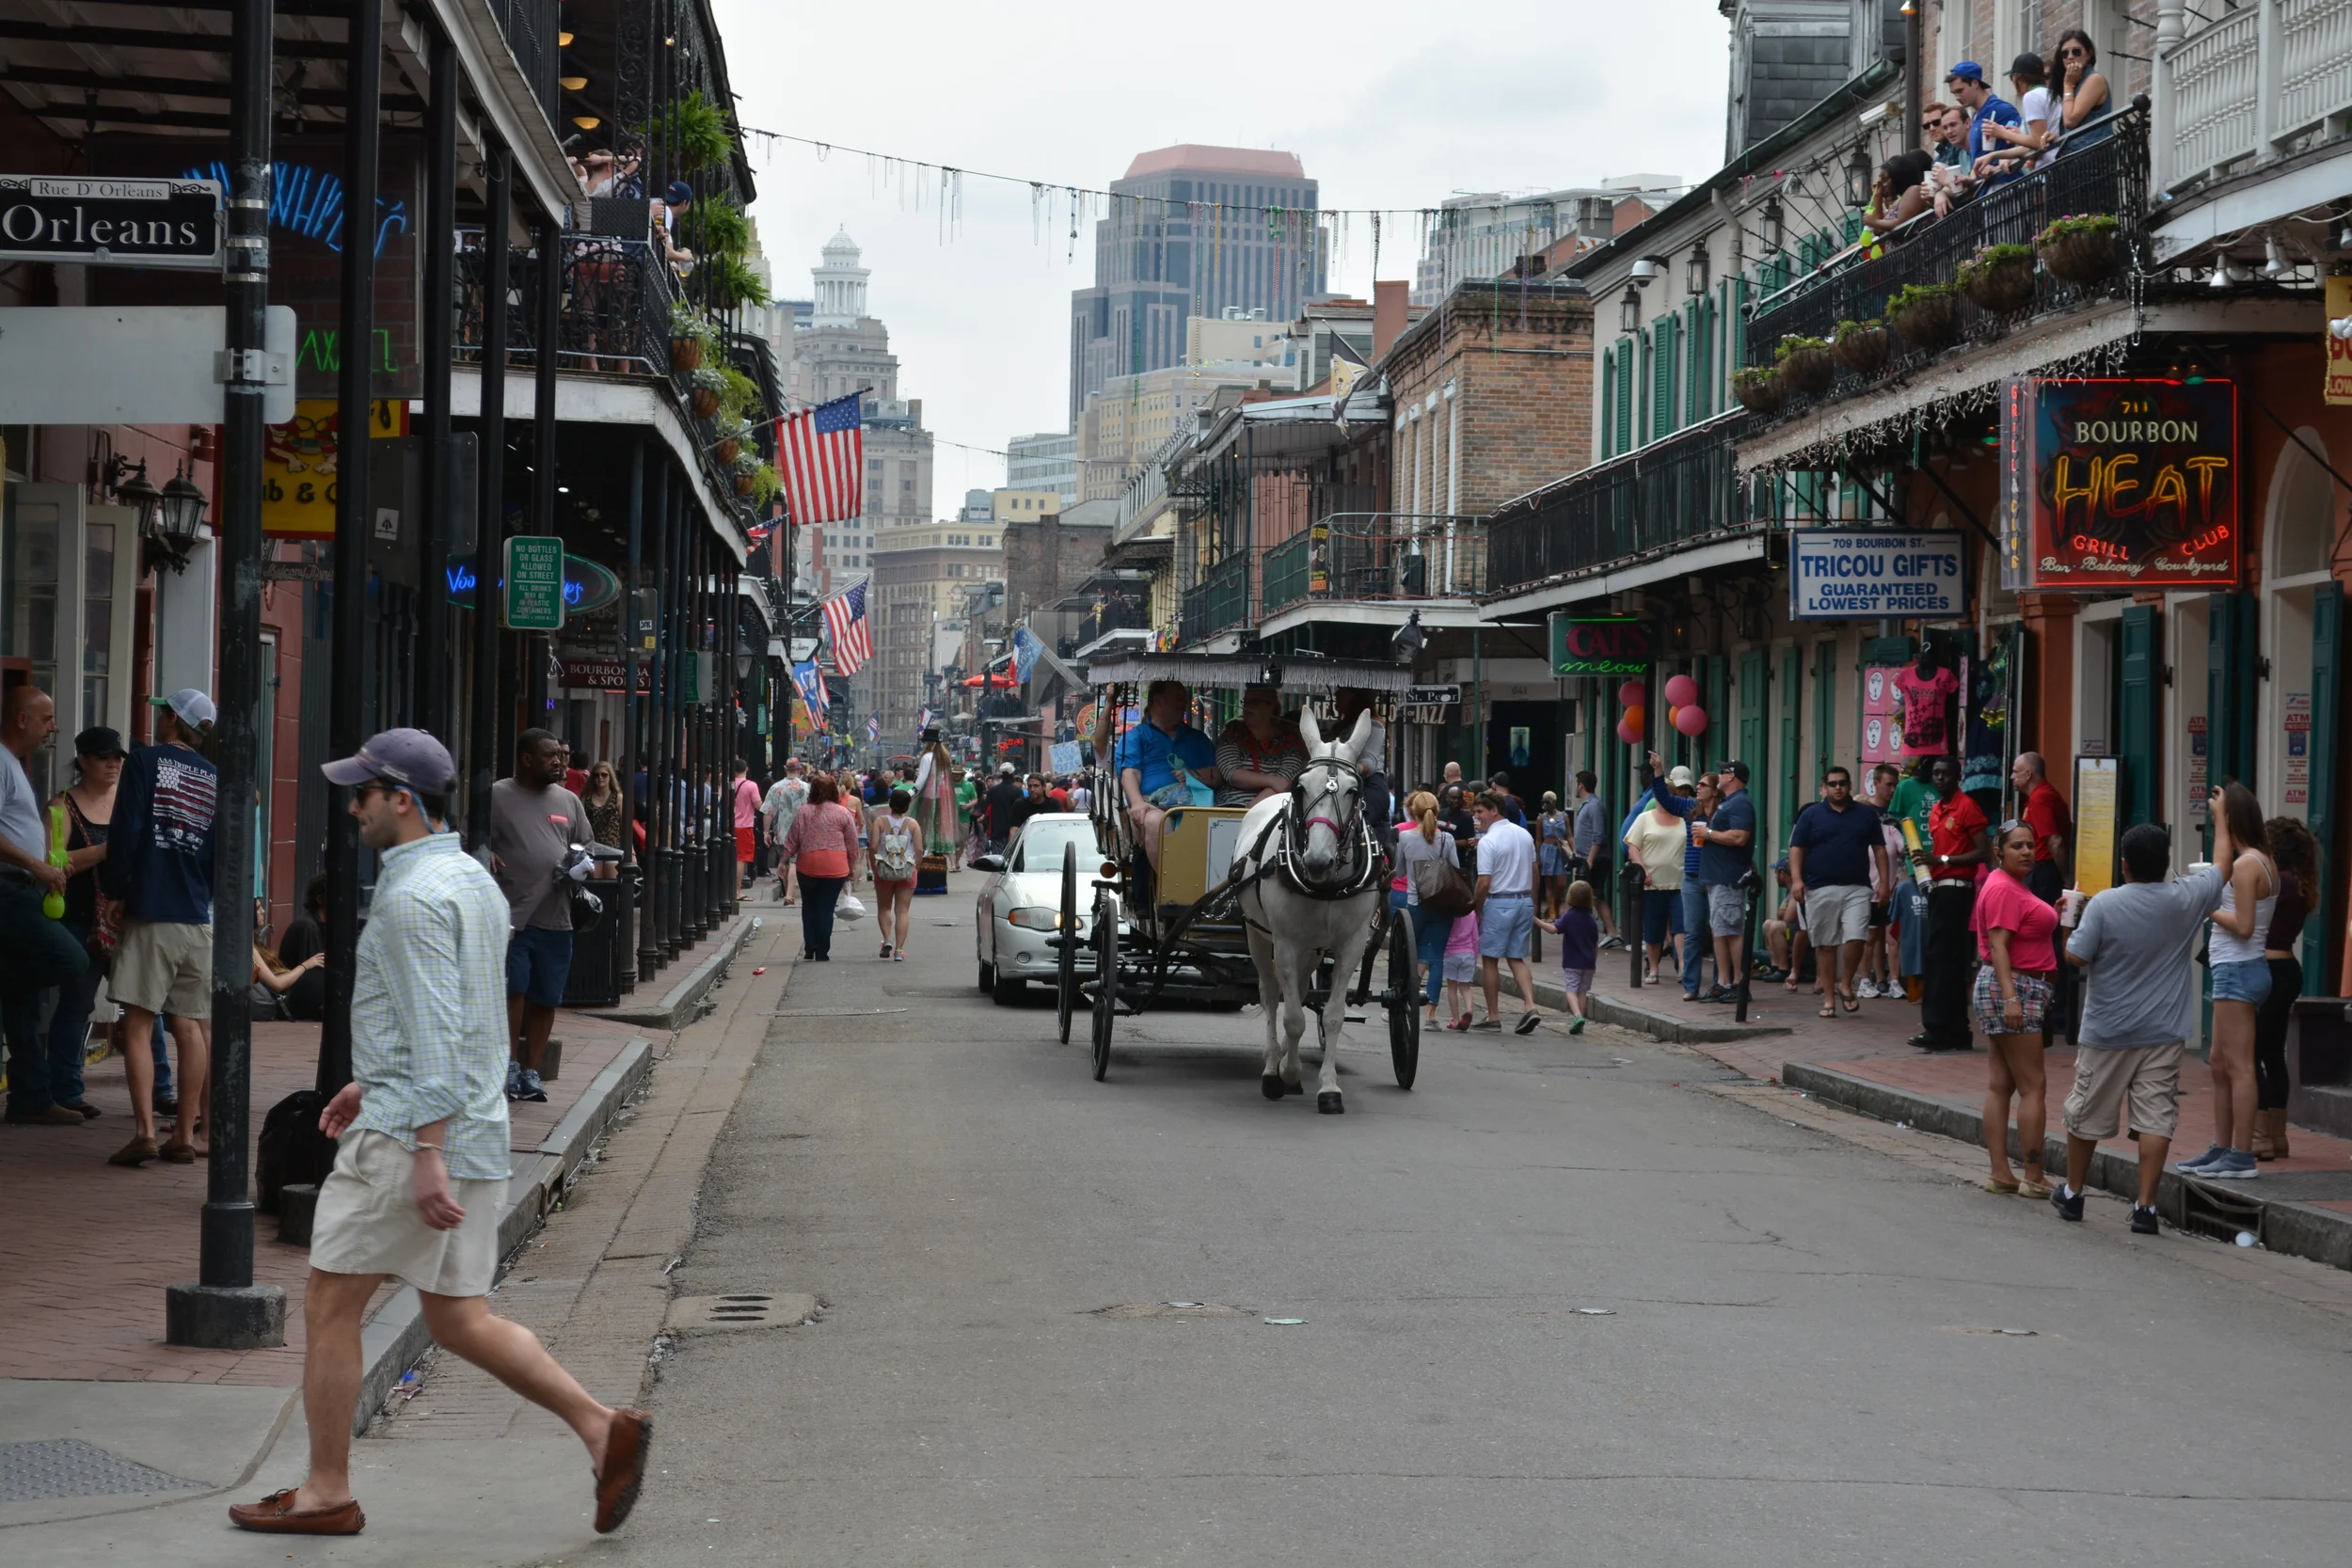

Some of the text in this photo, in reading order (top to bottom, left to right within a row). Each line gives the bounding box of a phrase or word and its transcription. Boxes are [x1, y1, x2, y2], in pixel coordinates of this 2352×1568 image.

[39, 182, 70, 196] Rue
[76, 182, 93, 196] D'
[2, 204, 197, 245] Orleans
[2122, 402, 2148, 414] 711
[2074, 420, 2199, 444] BOURBON
[2054, 453, 2229, 539] HEAT
[516, 545, 557, 554] NO BOTTLES
[1833, 538, 1926, 548] 709 BOURBON ST.
[2073, 525, 2230, 561] GRILL CLUB
[519, 553, 553, 562] OR GLASS
[520, 562, 552, 571] ALLOWED
[1801, 554, 1958, 578] TRICOU GIFTS
[2039, 557, 2228, 577] Bar Balcony Courtyard
[529, 571, 554, 579] STREET
[1820, 582, 1938, 596] GUARANTEED
[1809, 596, 1950, 610] LOWEST PRICES
[570, 664, 627, 676] BOURBON
[1558, 660, 1647, 673] meow
[1407, 692, 1457, 702] St. Per
[1412, 705, 1446, 724] JAZZ
[2286, 714, 2311, 722] ATM
[173, 760, 199, 774] TRIPLE
